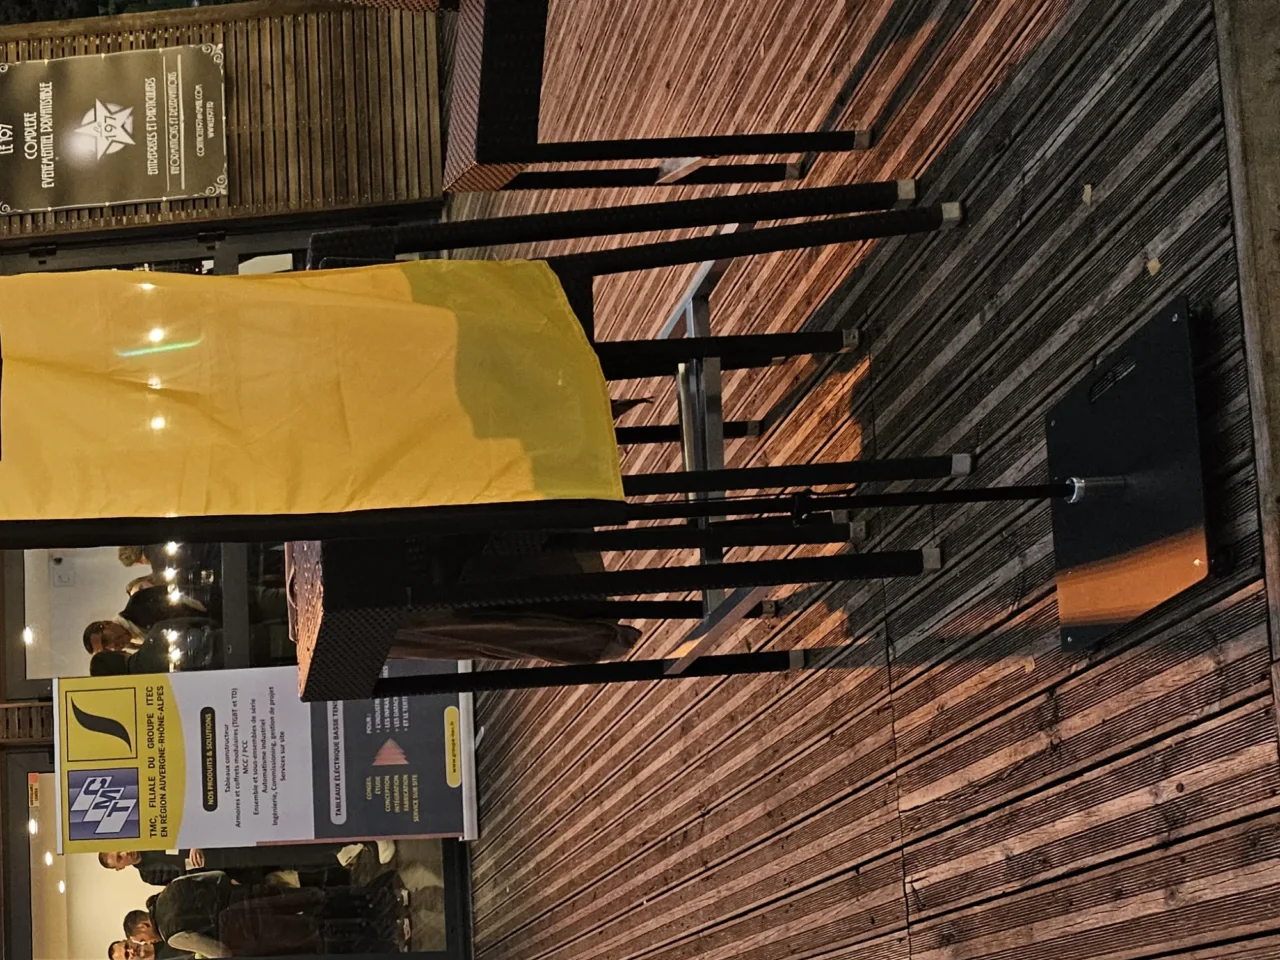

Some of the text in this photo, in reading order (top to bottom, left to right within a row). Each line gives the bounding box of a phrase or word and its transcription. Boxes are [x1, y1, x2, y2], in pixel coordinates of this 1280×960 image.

[0, 124, 13, 154] LE 197
[24, 112, 37, 159] COMPLEXE
[39, 81, 54, 188] EVENEMENTIEL PRIVATISABLE
[94, 122, 102, 138] Le
[104, 115, 116, 141] 197
[145, 77, 158, 175] ENTREPRISES ET PARTICULIERS
[169, 125, 180, 174] INFORMATIONS
[250, 715, 256, 724] de
[269, 707, 275, 715] de
[374, 699, 382, 729] L'INDUSTRI
[146, 713, 154, 749] GROUPE
[147, 757, 155, 768] DU
[156, 685, 168, 837] EN RÉGION AUVERGNE-RHÔNE-ALPES
[250, 725, 258, 775] sous-ensembles
[333, 741, 341, 781] ÉLÉCTRIQUE
[148, 776, 156, 808] FILIALE
[334, 782, 342, 816] TABLEAUX
[402, 774, 410, 812] FABRICATION
[149, 815, 158, 838] TMC,
